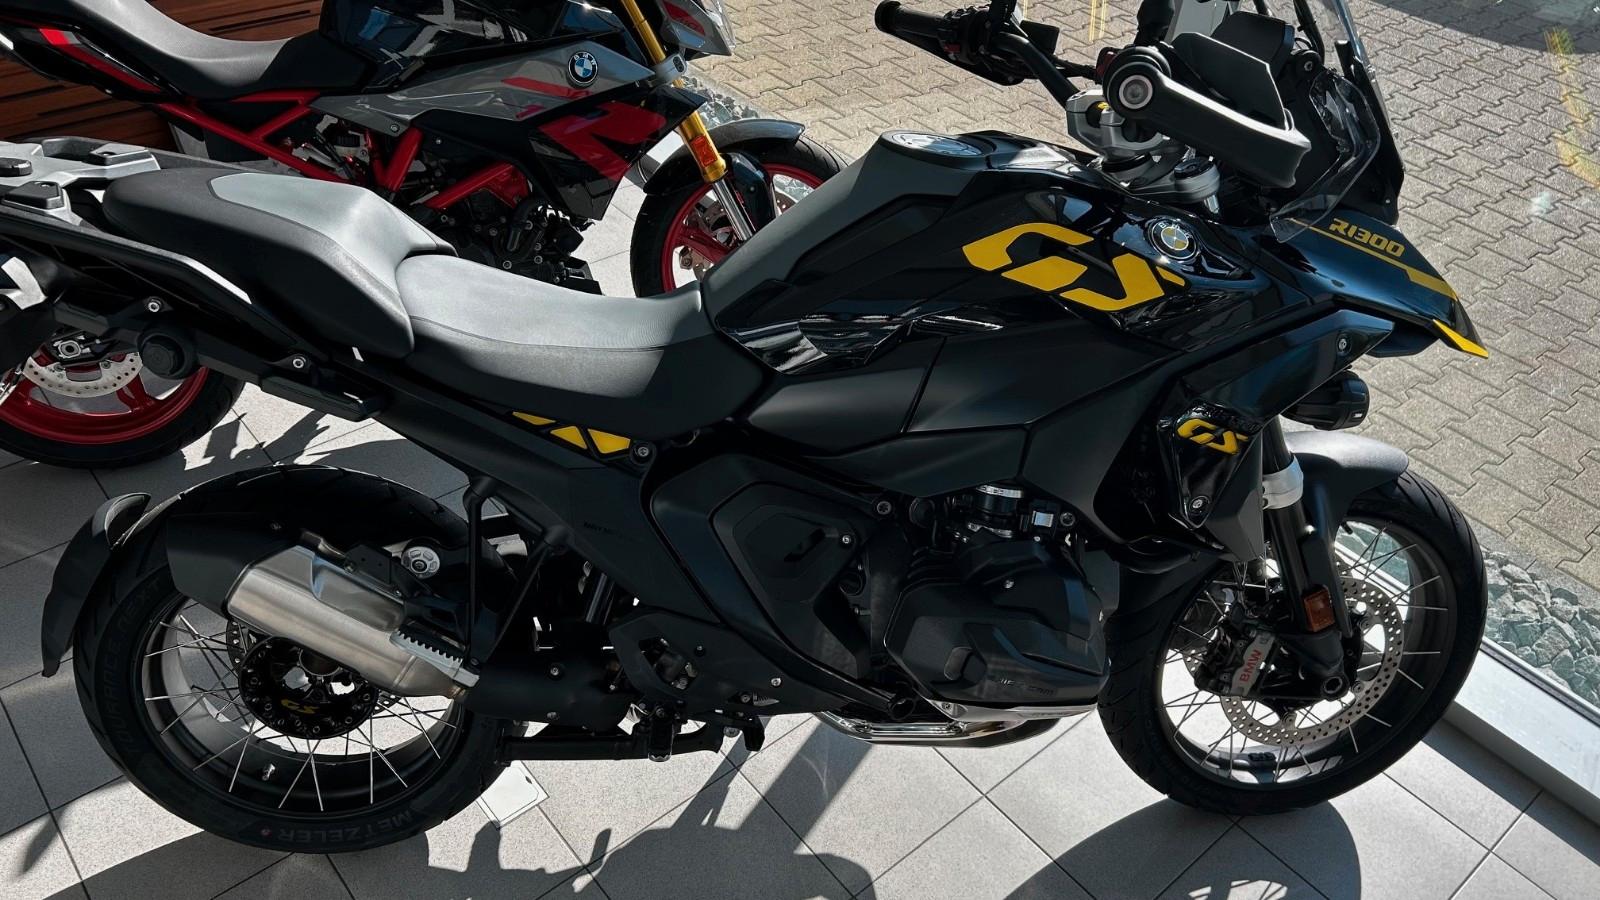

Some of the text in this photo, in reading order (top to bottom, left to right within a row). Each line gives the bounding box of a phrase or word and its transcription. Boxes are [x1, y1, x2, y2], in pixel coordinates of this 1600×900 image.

[573, 53, 597, 66] BMW
[1158, 222, 1194, 239] BMW
[1329, 218, 1405, 257] R1300
[962, 222, 1185, 311] GS
[1177, 418, 1249, 455] GS
[1239, 649, 1263, 682] BMW
[280, 698, 320, 715] GS
[277, 809, 416, 843] METZELER
